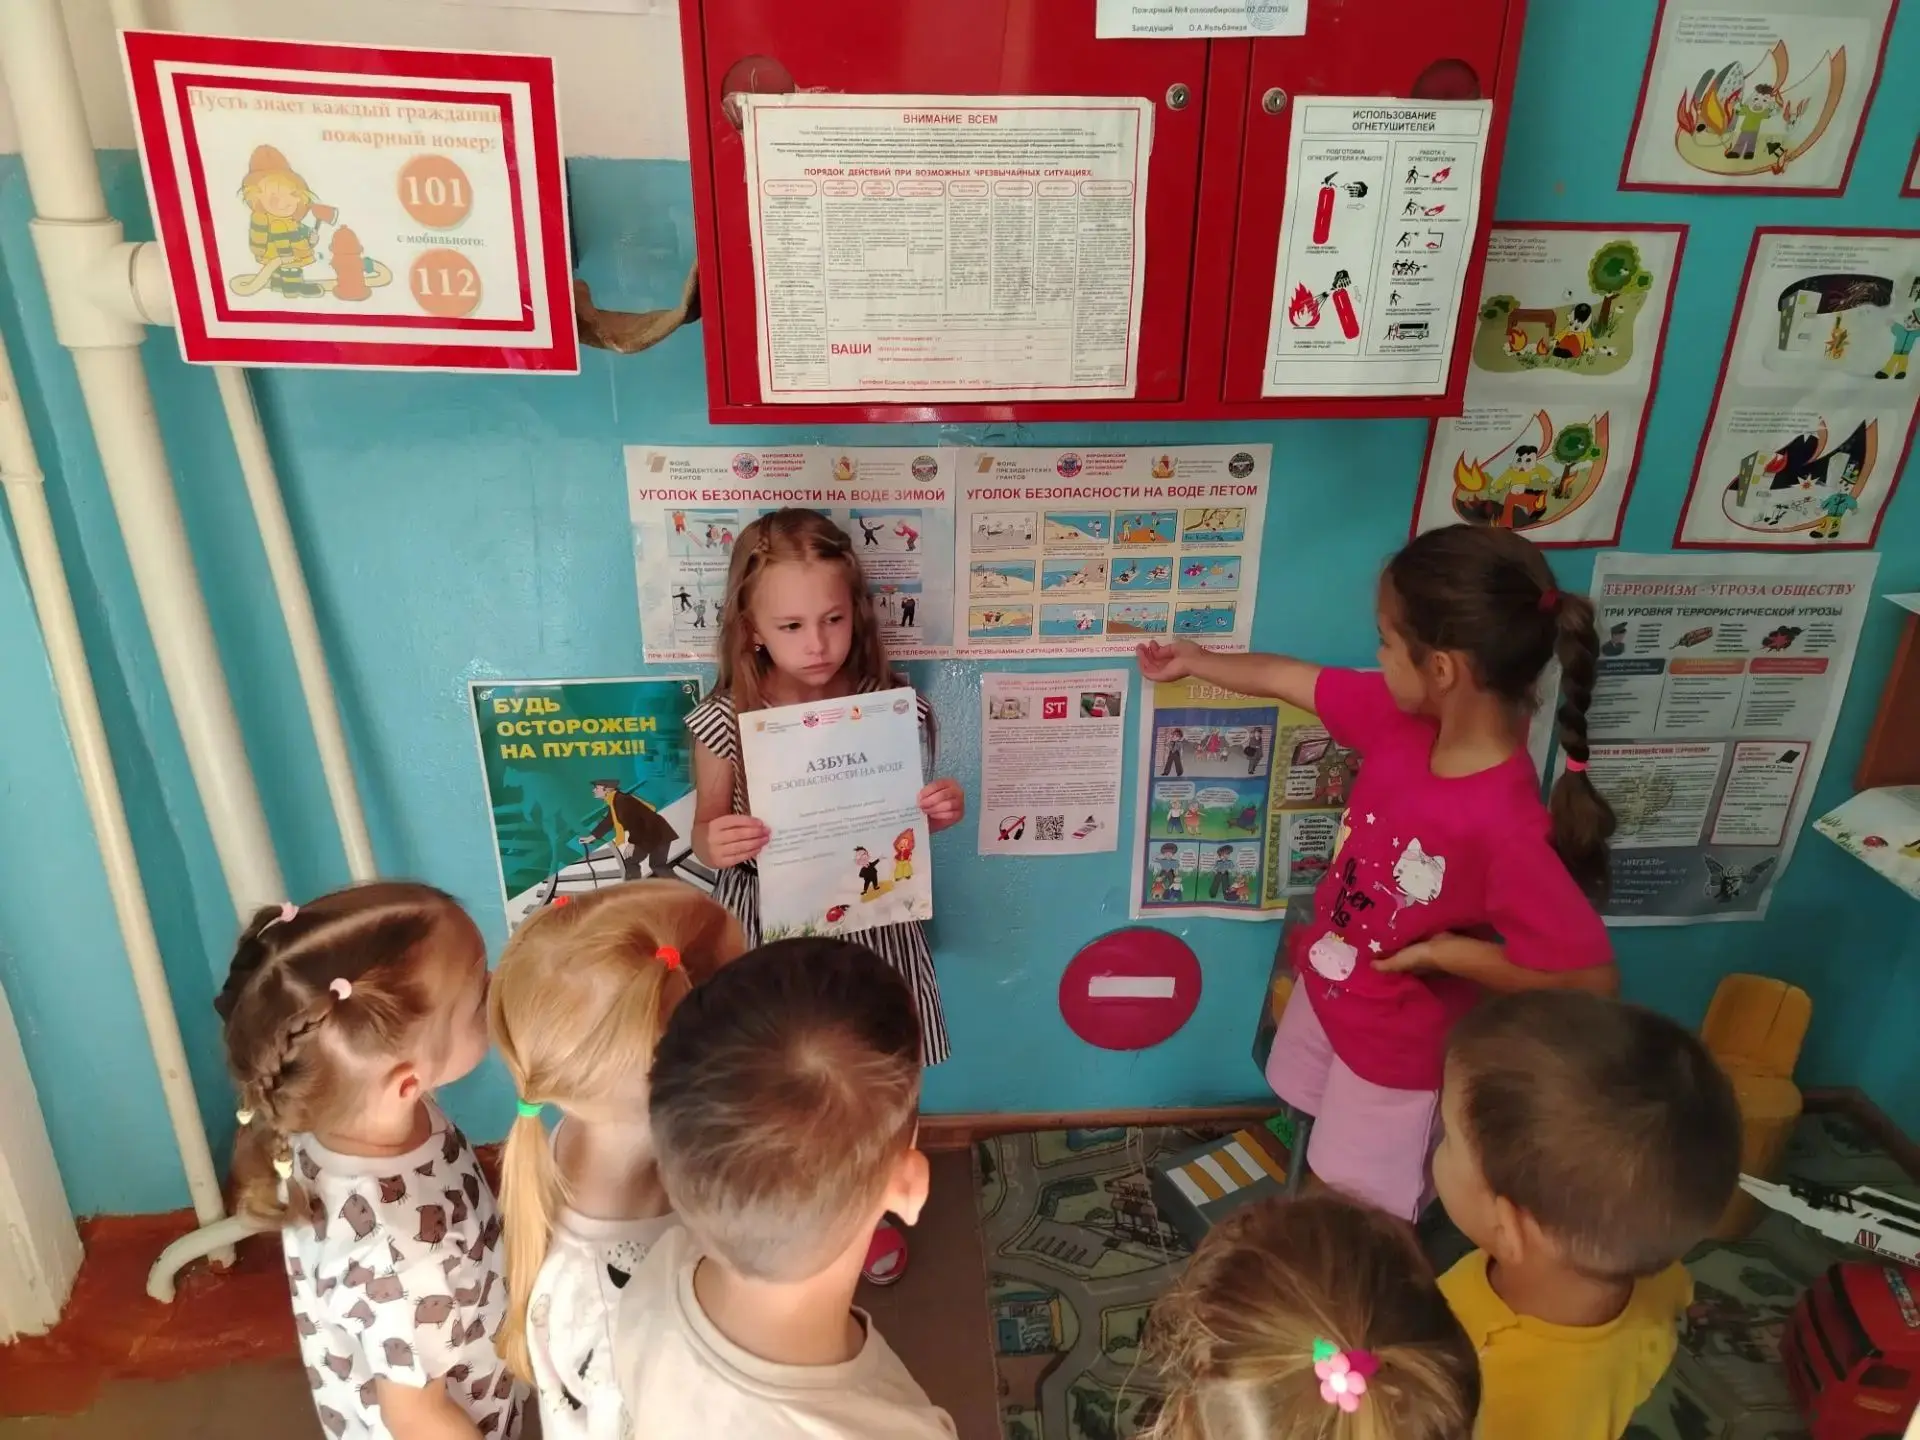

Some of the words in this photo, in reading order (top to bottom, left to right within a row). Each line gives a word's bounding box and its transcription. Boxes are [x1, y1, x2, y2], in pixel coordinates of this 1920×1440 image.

[188, 89, 249, 112] Пусть
[252, 96, 305, 114] знает
[311, 99, 390, 120] каждый
[902, 114, 964, 125] ВНИМАНИЕ
[967, 114, 998, 125] ВСЕМ
[1352, 110, 1437, 121] ИСПОЛЬЗОВАНИЕ
[1351, 121, 1436, 132] ОГНЕТУШИТЕЛЕЙ
[321, 128, 426, 149] пожарный
[430, 132, 498, 153] номер:
[804, 168, 845, 176] ПОРЯДОК
[847, 167, 891, 177] ДЕЙСТВИЙ
[894, 168, 912, 177] ПРИ
[915, 168, 971, 177] ВОЗМОЖНЫХ
[975, 168, 1041, 177] ЧРЕЗВЫЧАЙНЫХ
[403, 175, 468, 209] 101
[396, 234, 405, 245] с
[406, 232, 486, 248] мобильного:
[415, 266, 477, 298] 112
[830, 342, 873, 356] ВАШИ
[639, 489, 698, 501] УГОЛОК
[701, 489, 823, 501] БЕЗОПАСНОСТИ
[826, 489, 847, 501] НА
[851, 489, 890, 501] ВОДЕ
[894, 486, 946, 501] ЗИМОЙ
[966, 487, 1022, 501] УГОЛОК
[1025, 486, 1140, 500] БЕЗОПАСНОСТИ
[1143, 486, 1163, 498] НА
[1167, 486, 1207, 499] ВОДЕ
[1210, 485, 1258, 497] ЛЕТОМ
[1605, 583, 1697, 597] ТЕРРОРИЗМ
[1709, 583, 1767, 597] УГРОЗА
[1771, 583, 1856, 598] ОБЩЕСТВУ
[1604, 607, 1625, 618] ТРИ
[1627, 607, 1673, 618] УРОВНЯ
[1676, 605, 1796, 618] ТЕРРОРИСТИЧЕСКОЙ
[1798, 607, 1843, 618] УГРОЗЫ
[493, 697, 561, 716] БУДЬ
[1044, 702, 1066, 714] ST
[496, 716, 657, 737] ОСТОРОЖЕН
[501, 743, 537, 760] НА
[542, 739, 646, 758] ПУТЯХ!!!
[806, 751, 869, 774] АЗБУКА
[770, 769, 859, 793] БЕЗОПАСНОСТИ
[859, 767, 876, 779] НА
[878, 760, 905, 775] ВОДЕ
